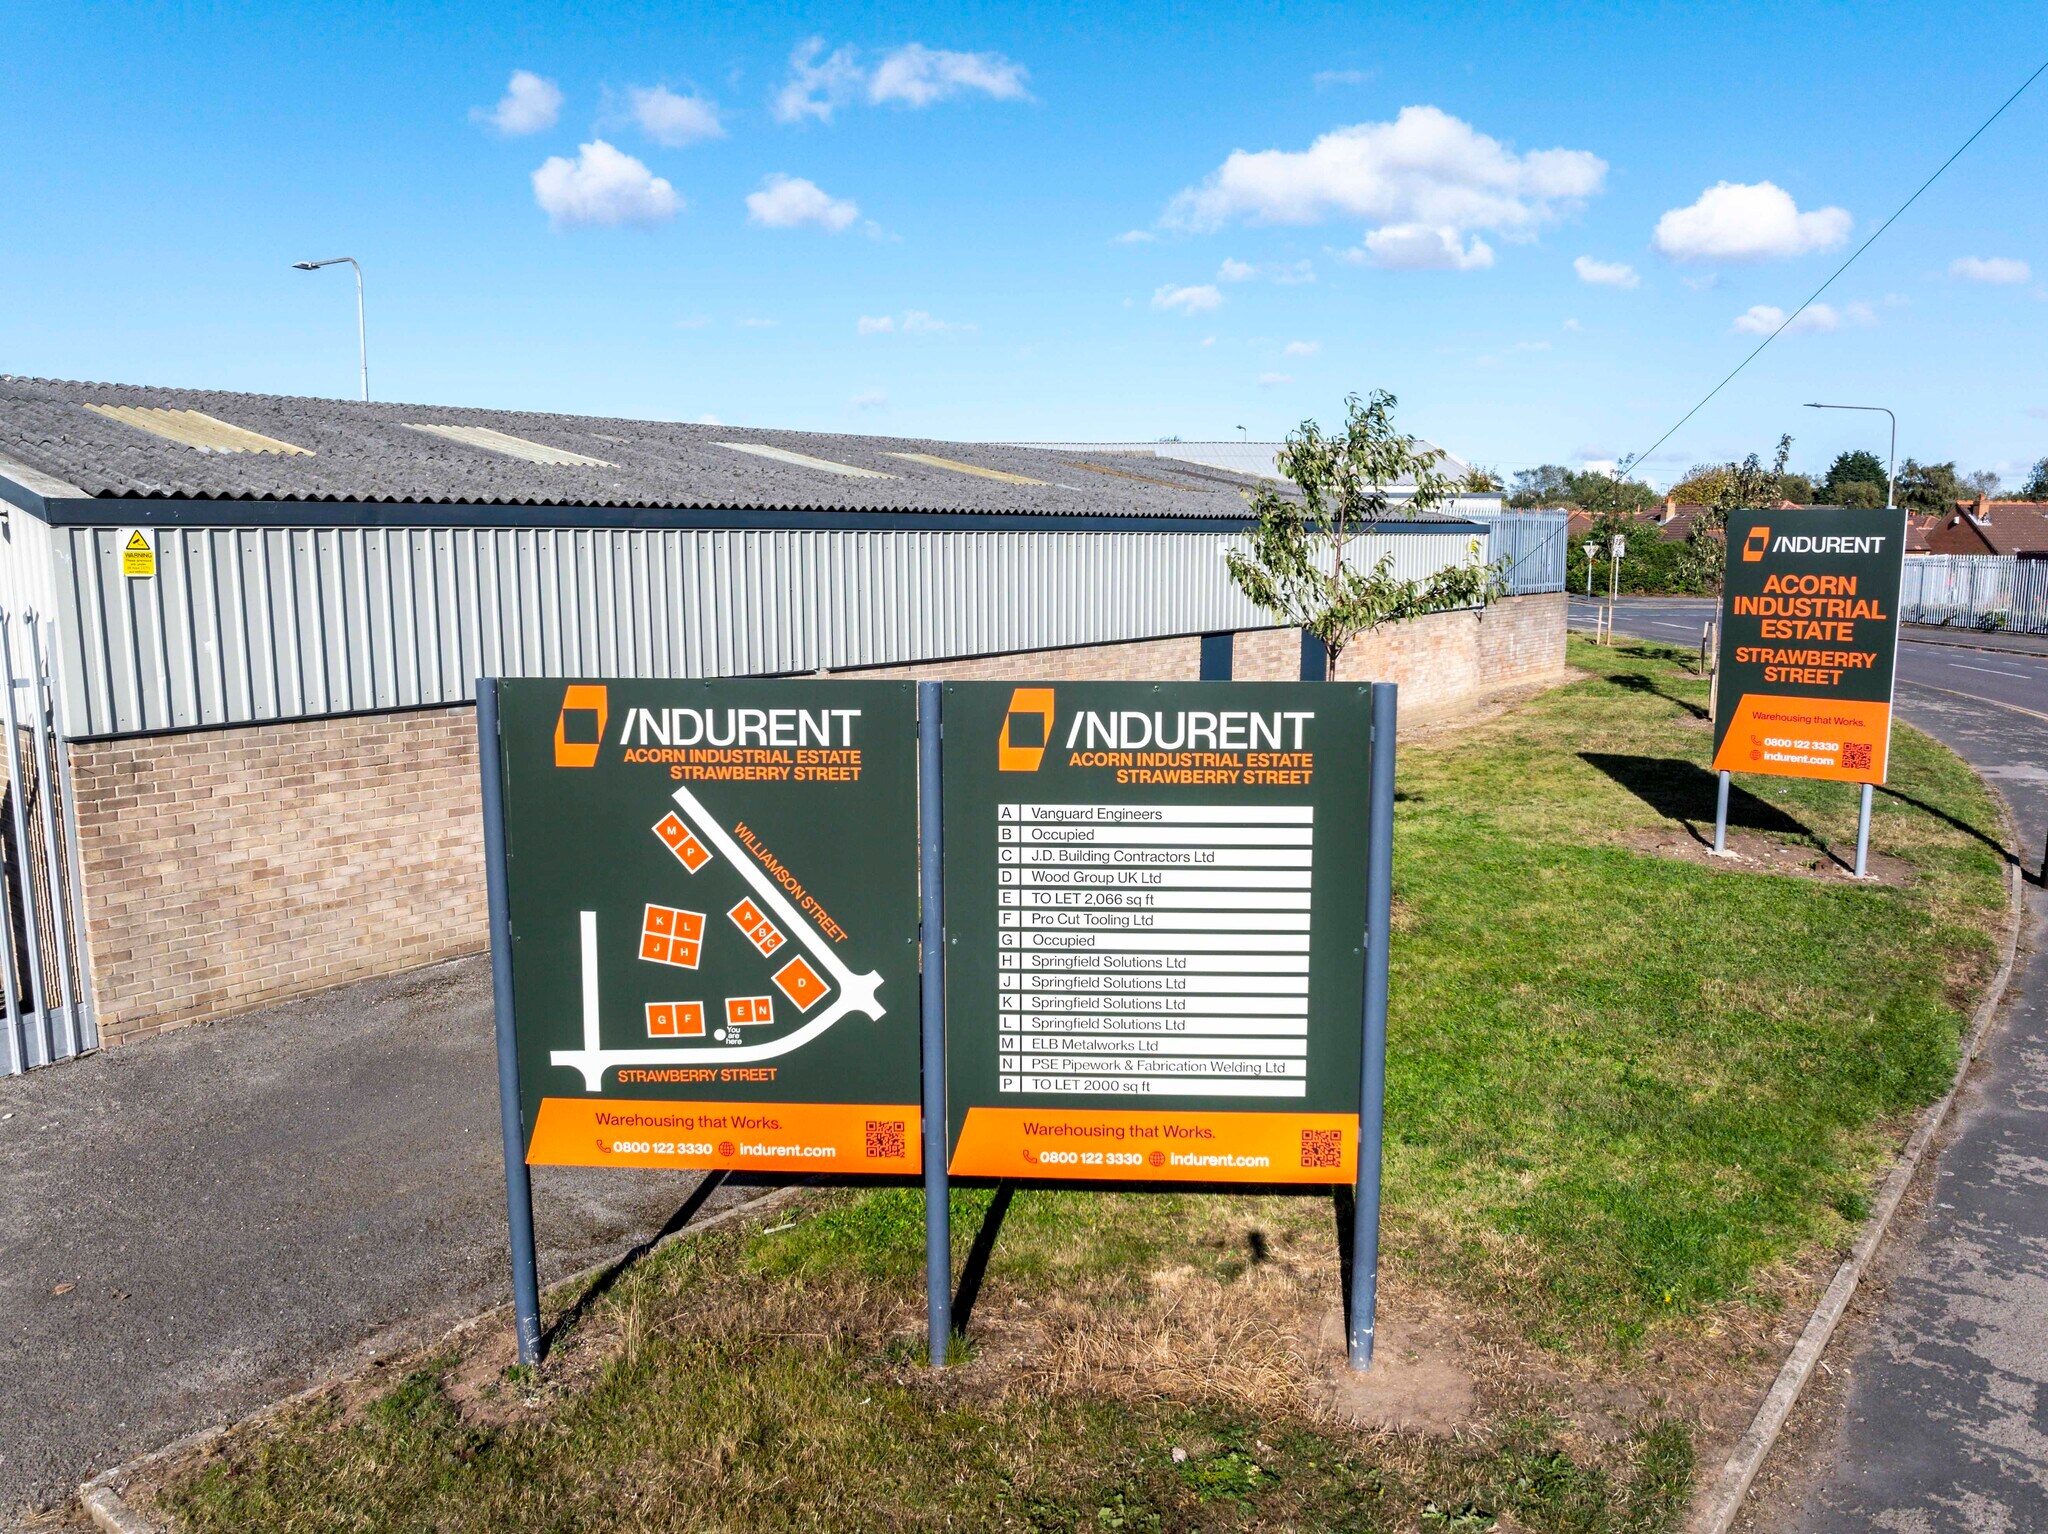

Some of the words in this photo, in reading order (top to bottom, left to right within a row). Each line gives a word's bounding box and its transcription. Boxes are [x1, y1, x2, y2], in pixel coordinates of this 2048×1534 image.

[1763, 575, 1857, 595] ACORN
[1734, 597, 1886, 619] INDUSTRIAL
[1761, 619, 1854, 641] ESTATE
[1736, 647, 1877, 669] STRAWBERRY
[1764, 667, 1843, 685] STREET
[1753, 712, 1811, 724] Warehousing
[1814, 716, 1832, 725] that
[1834, 717, 1866, 727] Works.
[1764, 737, 1791, 748] 0800
[1793, 739, 1809, 749] 122
[1811, 741, 1839, 751] 3330
[624, 749, 686, 763] ACORN
[689, 749, 793, 764] INDUSTRIAL
[797, 750, 861, 764] ESTATE
[1069, 753, 1132, 766] ACORN
[1137, 753, 1243, 767] INDUSTRIAL
[1247, 753, 1313, 767] ESTATE
[1764, 751, 1834, 766] indurent.com
[670, 766, 792, 780] STRAWBERRY
[794, 767, 861, 781] STREET
[1117, 770, 1239, 783] STRAWBERRY
[1243, 771, 1313, 784] STREET
[1001, 807, 1012, 819] A
[1032, 807, 1093, 822] Vanguard
[1097, 808, 1162, 823] Engineers
[667, 826, 676, 835] M
[1002, 829, 1012, 840] B
[1032, 828, 1095, 843] Occupied
[687, 848, 695, 857] P
[1002, 850, 1012, 861] C
[1032, 850, 1055, 861] J.D.
[1059, 850, 1110, 865] Building
[1114, 851, 1190, 864] Contractors
[1194, 851, 1215, 863] Ltd
[733, 821, 805, 901] WILLIAMSON
[800, 896, 848, 943] STREET
[1002, 871, 1012, 882] D
[1032, 871, 1070, 883] Wood
[1073, 872, 1114, 886] Group
[1118, 872, 1138, 884] UK
[1142, 872, 1162, 884] Ltd
[1003, 893, 1011, 903] E
[1032, 893, 1052, 904] TO
[1055, 893, 1081, 904] LET
[1084, 893, 1123, 907] 2,066
[1126, 897, 1142, 908] sq
[1145, 894, 1154, 906] ft
[656, 916, 665, 926] K
[744, 911, 752, 921] A
[1003, 913, 1011, 924] F
[1032, 913, 1054, 925] Pro
[1057, 914, 1080, 926] Cut
[1083, 914, 1130, 929] Tooling
[1134, 915, 1154, 926] Ltd
[684, 923, 691, 931] L
[759, 929, 766, 937] B
[654, 943, 660, 952] J
[767, 939, 775, 948] C
[1002, 934, 1012, 946] G
[1032, 934, 1095, 949] Occupied
[680, 948, 688, 956] H
[1002, 955, 1012, 966] H
[1032, 955, 1100, 970] Springfield
[1103, 956, 1163, 969] Solutions
[1167, 958, 1186, 969] Ltd
[798, 978, 806, 988] D
[1003, 976, 1011, 987] J
[1032, 976, 1100, 991] Springfield
[1103, 977, 1163, 990] Solutions
[1167, 978, 1186, 990] Ltd
[737, 1007, 744, 1016] E
[759, 1006, 767, 1015] N
[1002, 997, 1012, 1008] K
[1032, 997, 1100, 1012] Springfield
[1103, 998, 1163, 1011] Solutions
[1167, 999, 1186, 1011] Ltd
[658, 1015, 666, 1024] G
[684, 1014, 691, 1023] F
[1002, 1017, 1012, 1028] L
[1032, 1017, 1100, 1032] Springfield
[1103, 1018, 1163, 1031] Solutions
[1167, 1019, 1186, 1031] Ltd
[726, 1026, 741, 1034] You
[1002, 1038, 1013, 1049] M
[1032, 1038, 1058, 1050] ELB
[1062, 1039, 1135, 1051] Metalworks
[1139, 1040, 1158, 1052] Ltd
[1003, 1058, 1012, 1069] N
[1032, 1058, 1058, 1071] PSE
[1063, 1059, 1121, 1075] Pipework
[1125, 1060, 1134, 1072] &
[1138, 1060, 1207, 1072] Fabrication
[1211, 1061, 1262, 1076] Welding
[1266, 1062, 1285, 1074] Ltd
[618, 1069, 717, 1083] STRAWBERRY
[720, 1067, 777, 1082] STREET
[1004, 1078, 1012, 1089] P
[1032, 1079, 1052, 1091] TO
[1055, 1079, 1081, 1091] LET
[1084, 1080, 1119, 1092] 2000
[1123, 1083, 1138, 1094] sq
[1142, 1080, 1151, 1092] ft
[596, 1113, 694, 1130] Warehousing
[698, 1116, 727, 1129] that
[730, 1116, 782, 1130] Works.
[1023, 1123, 1125, 1140] Warehousing
[1129, 1124, 1159, 1138] that
[1162, 1125, 1216, 1139] Works.
[613, 1142, 650, 1154] 0800
[652, 1143, 675, 1154] 122
[677, 1143, 712, 1155] 3330
[740, 1143, 836, 1158] indurent.com
[1040, 1152, 1078, 1164] 0800
[1081, 1152, 1103, 1164] 122
[1106, 1152, 1142, 1165] 3330
[1170, 1152, 1269, 1168] indurent.com
